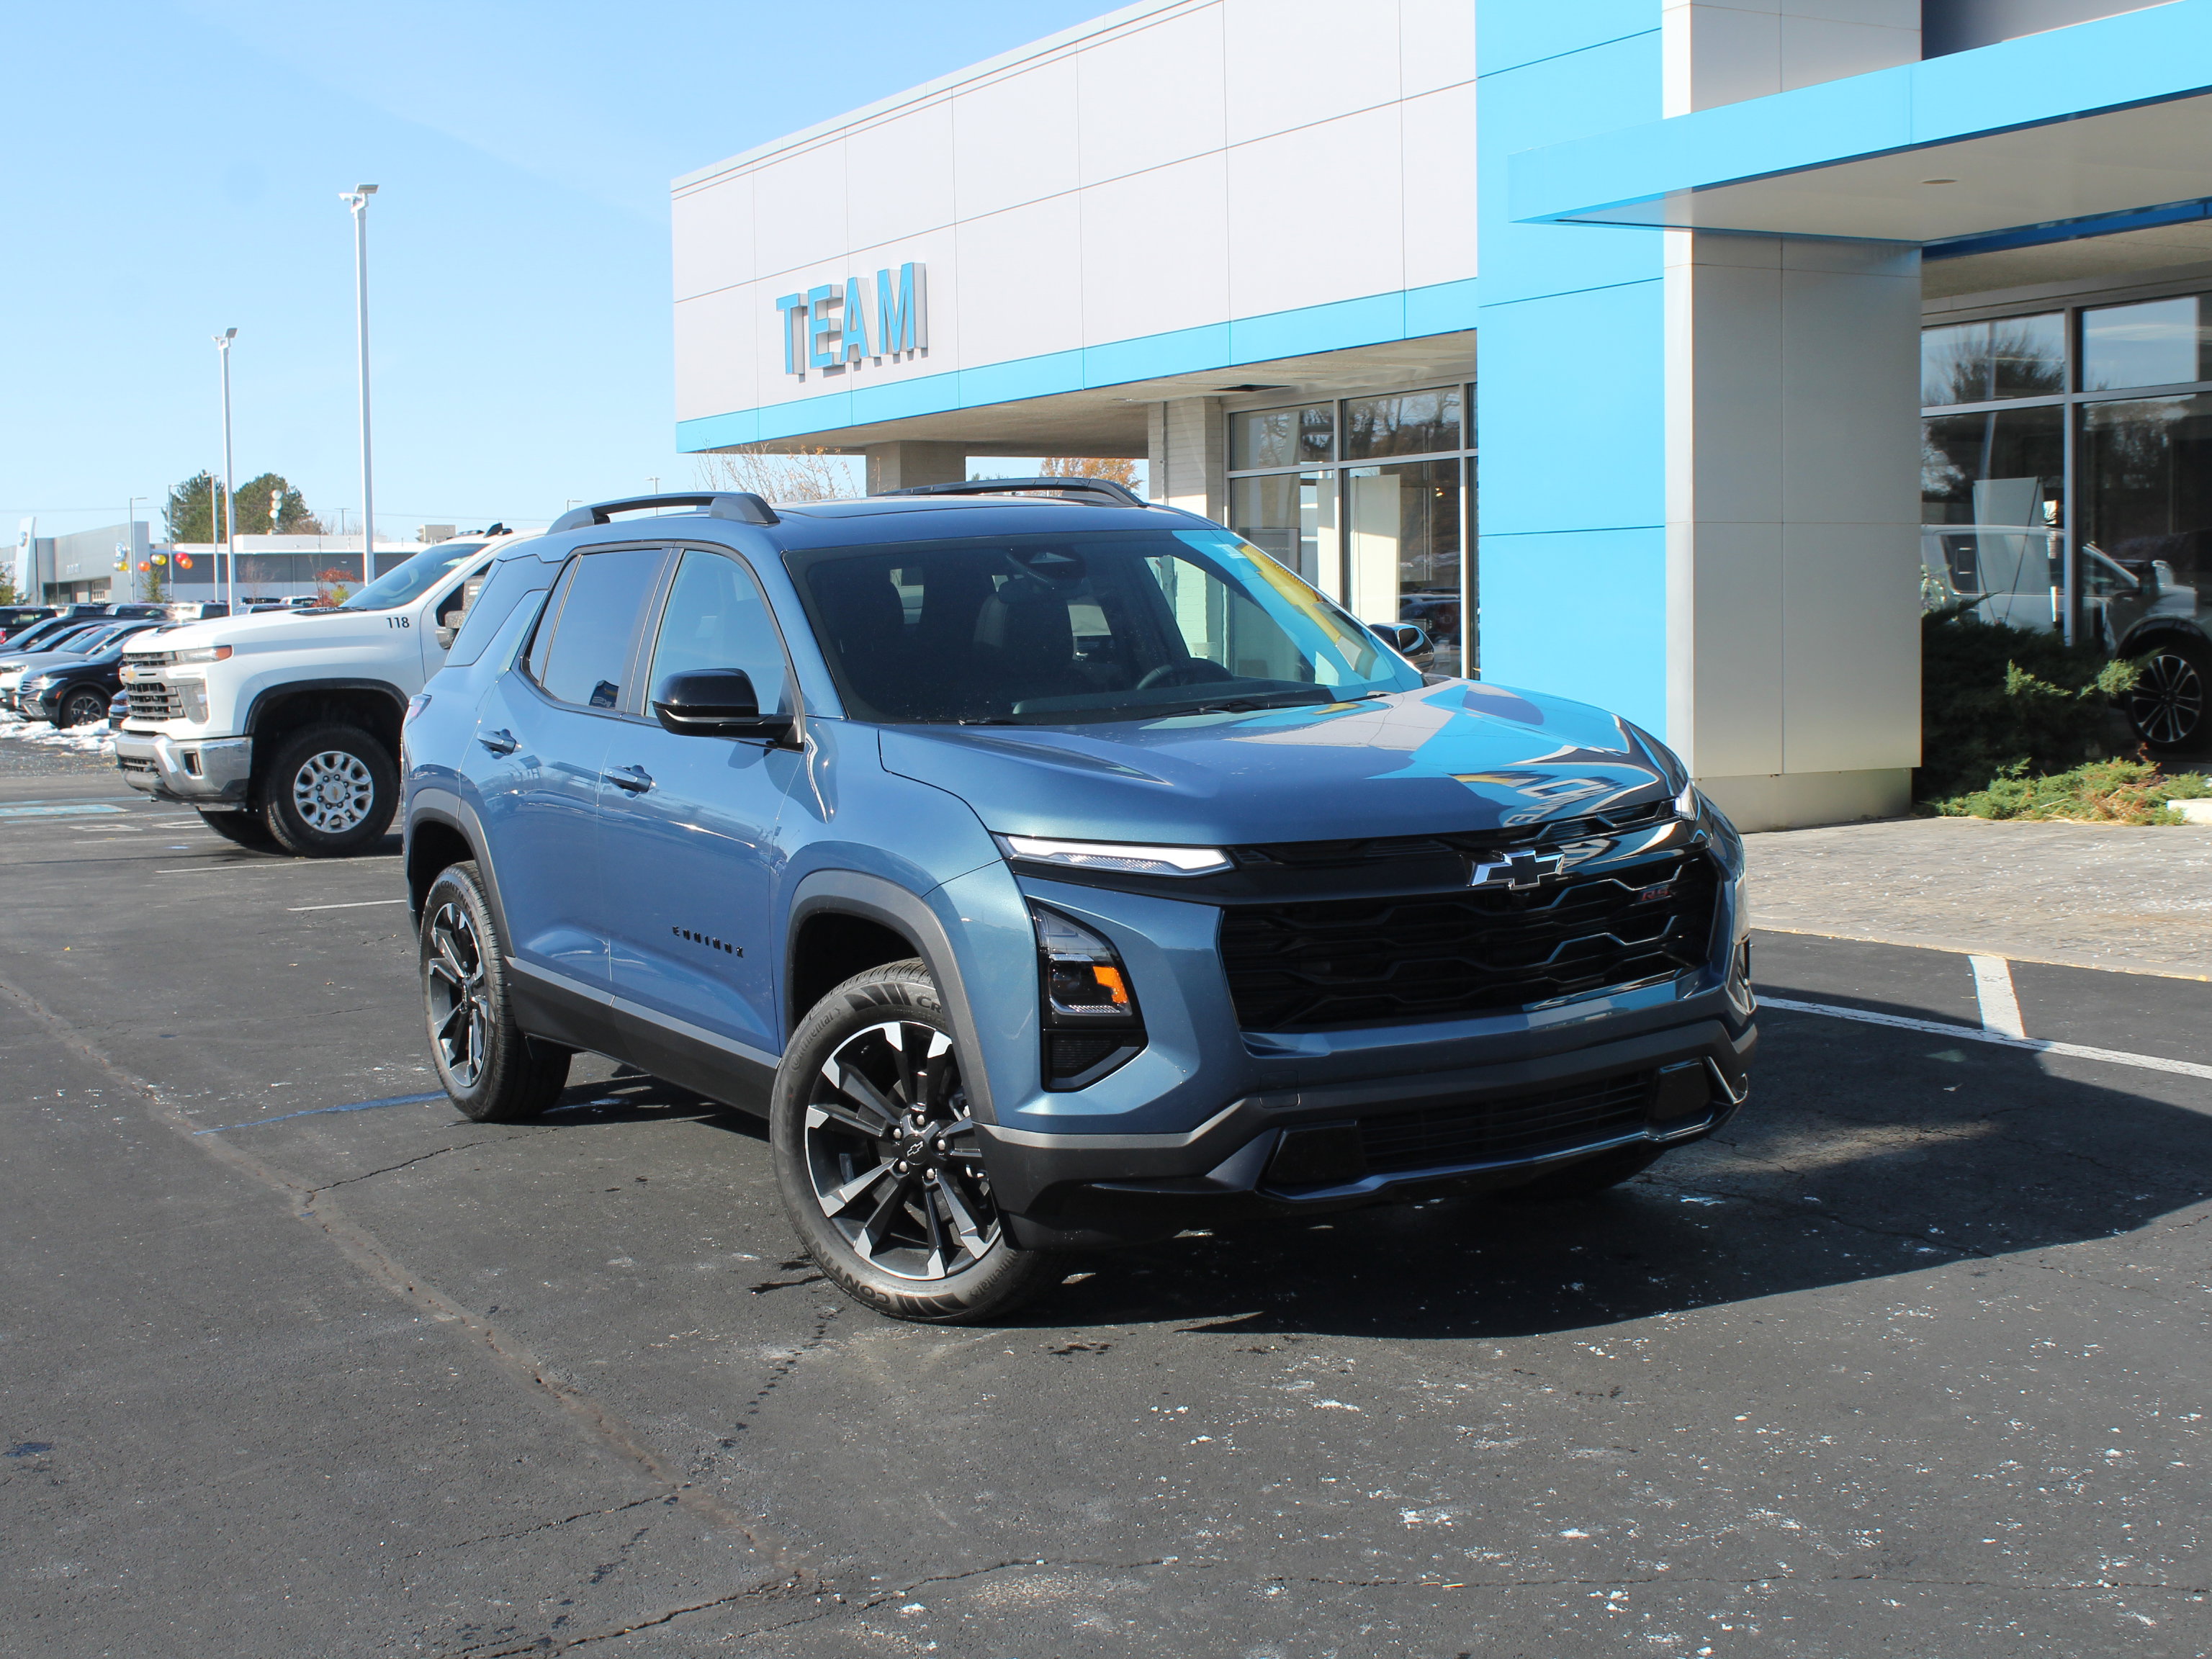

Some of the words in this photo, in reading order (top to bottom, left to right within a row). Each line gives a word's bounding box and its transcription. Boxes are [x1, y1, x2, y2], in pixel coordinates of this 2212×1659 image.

[776, 262, 927, 376] TEAM
[386, 616, 410, 629] 118
[917, 996, 943, 1014] CR
